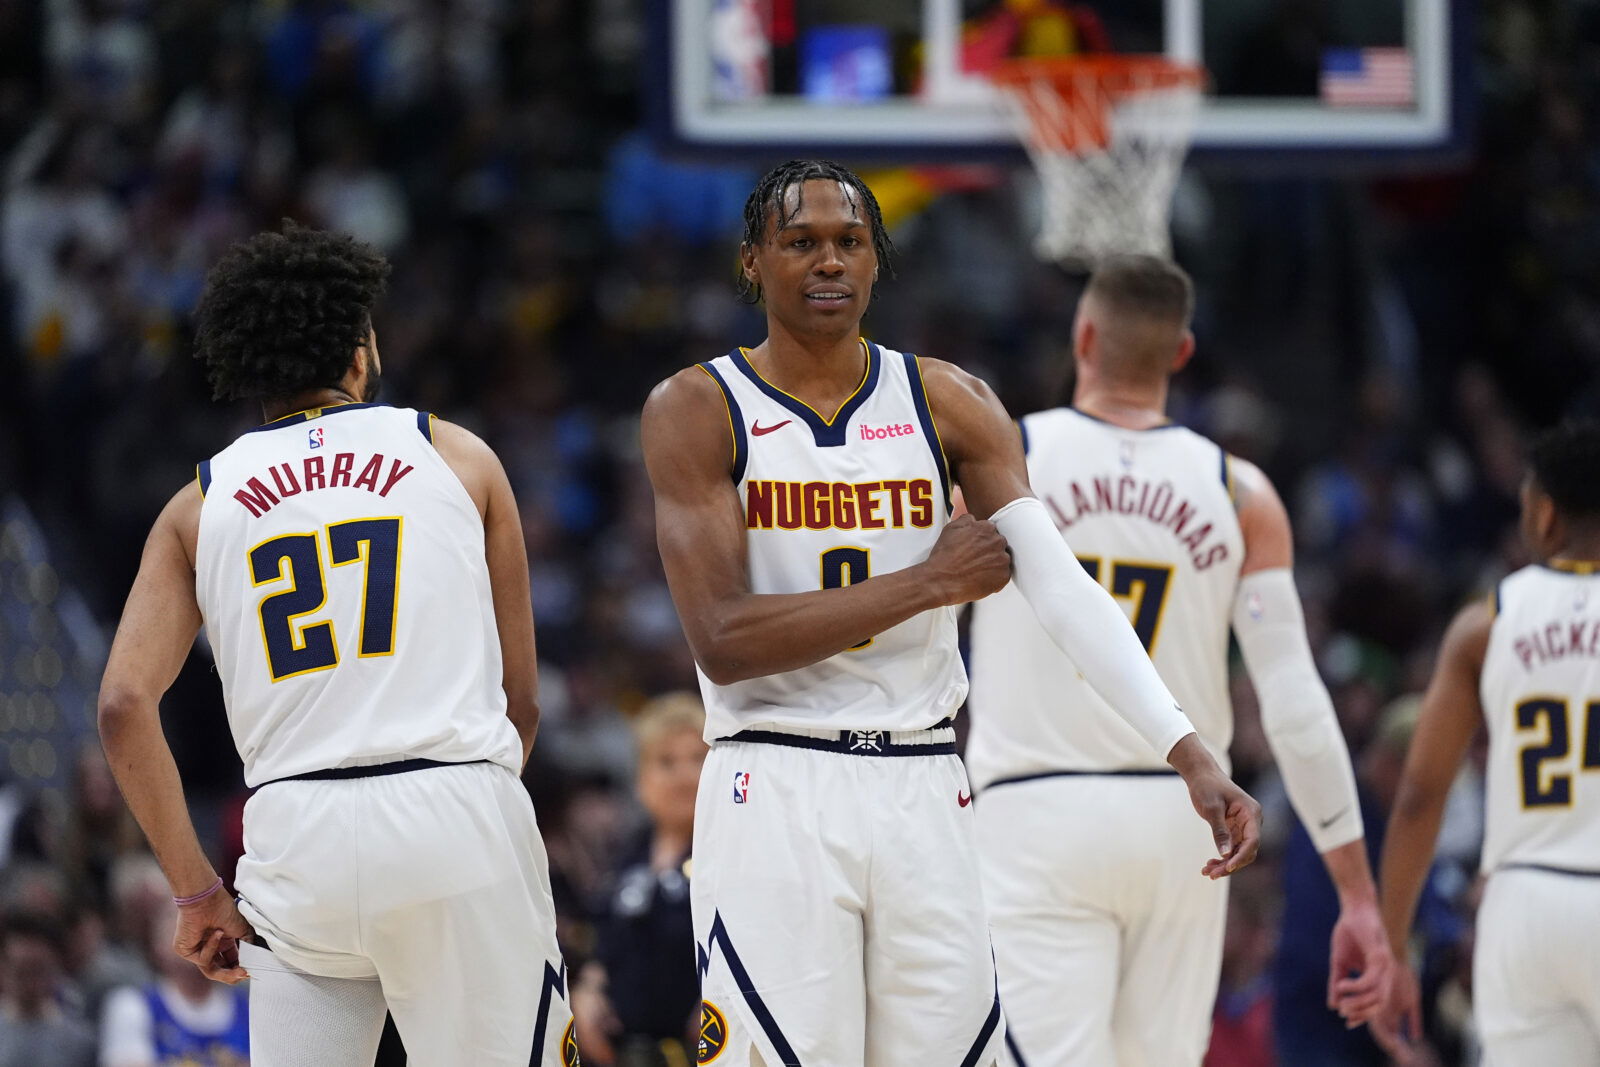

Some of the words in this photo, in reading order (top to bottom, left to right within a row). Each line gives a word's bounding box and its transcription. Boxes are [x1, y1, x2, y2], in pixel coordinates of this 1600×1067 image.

[860, 424, 915, 440] ibotta
[233, 452, 414, 518] MURRAY
[746, 478, 933, 531] NUGGETS
[247, 516, 403, 683] 27
[1073, 553, 1177, 662] 7
